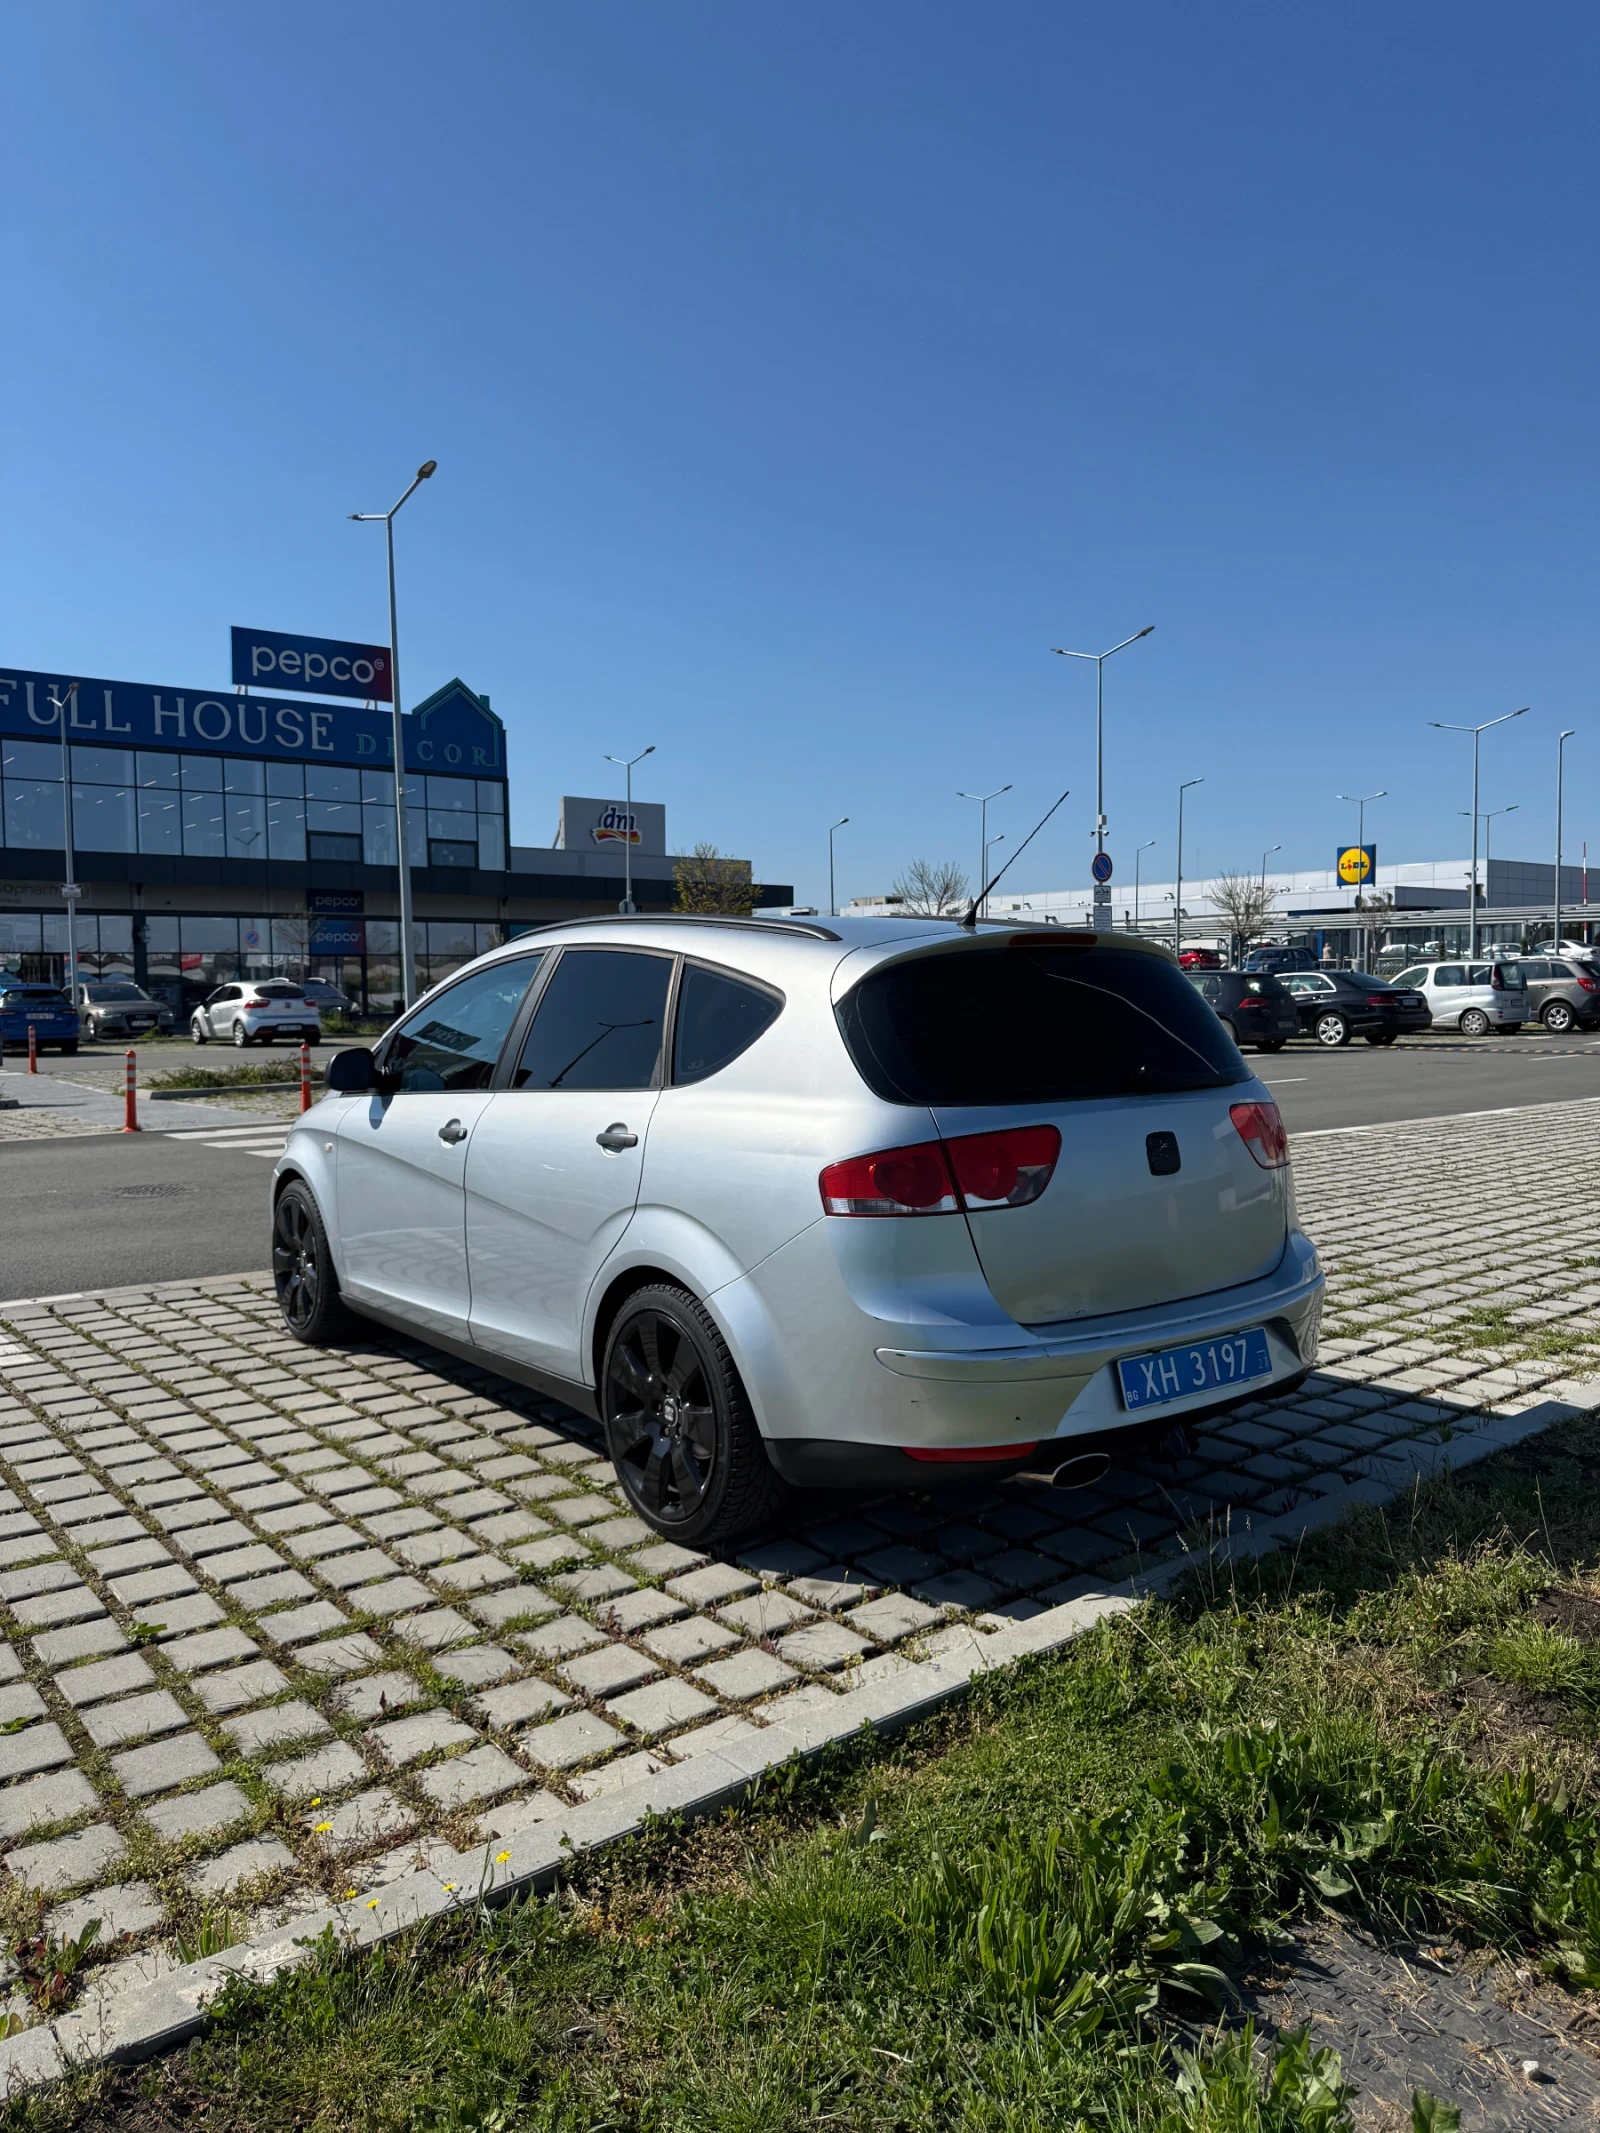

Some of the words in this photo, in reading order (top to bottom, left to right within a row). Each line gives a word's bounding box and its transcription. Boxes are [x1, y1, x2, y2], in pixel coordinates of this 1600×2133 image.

[0, 679, 131, 732] FULL
[153, 695, 334, 751] HOUSE
[603, 807, 635, 831] dm
[1140, 1356, 1180, 1399] XH
[1189, 1339, 1247, 1386] 3197
[1126, 1389, 1139, 1402] BG
